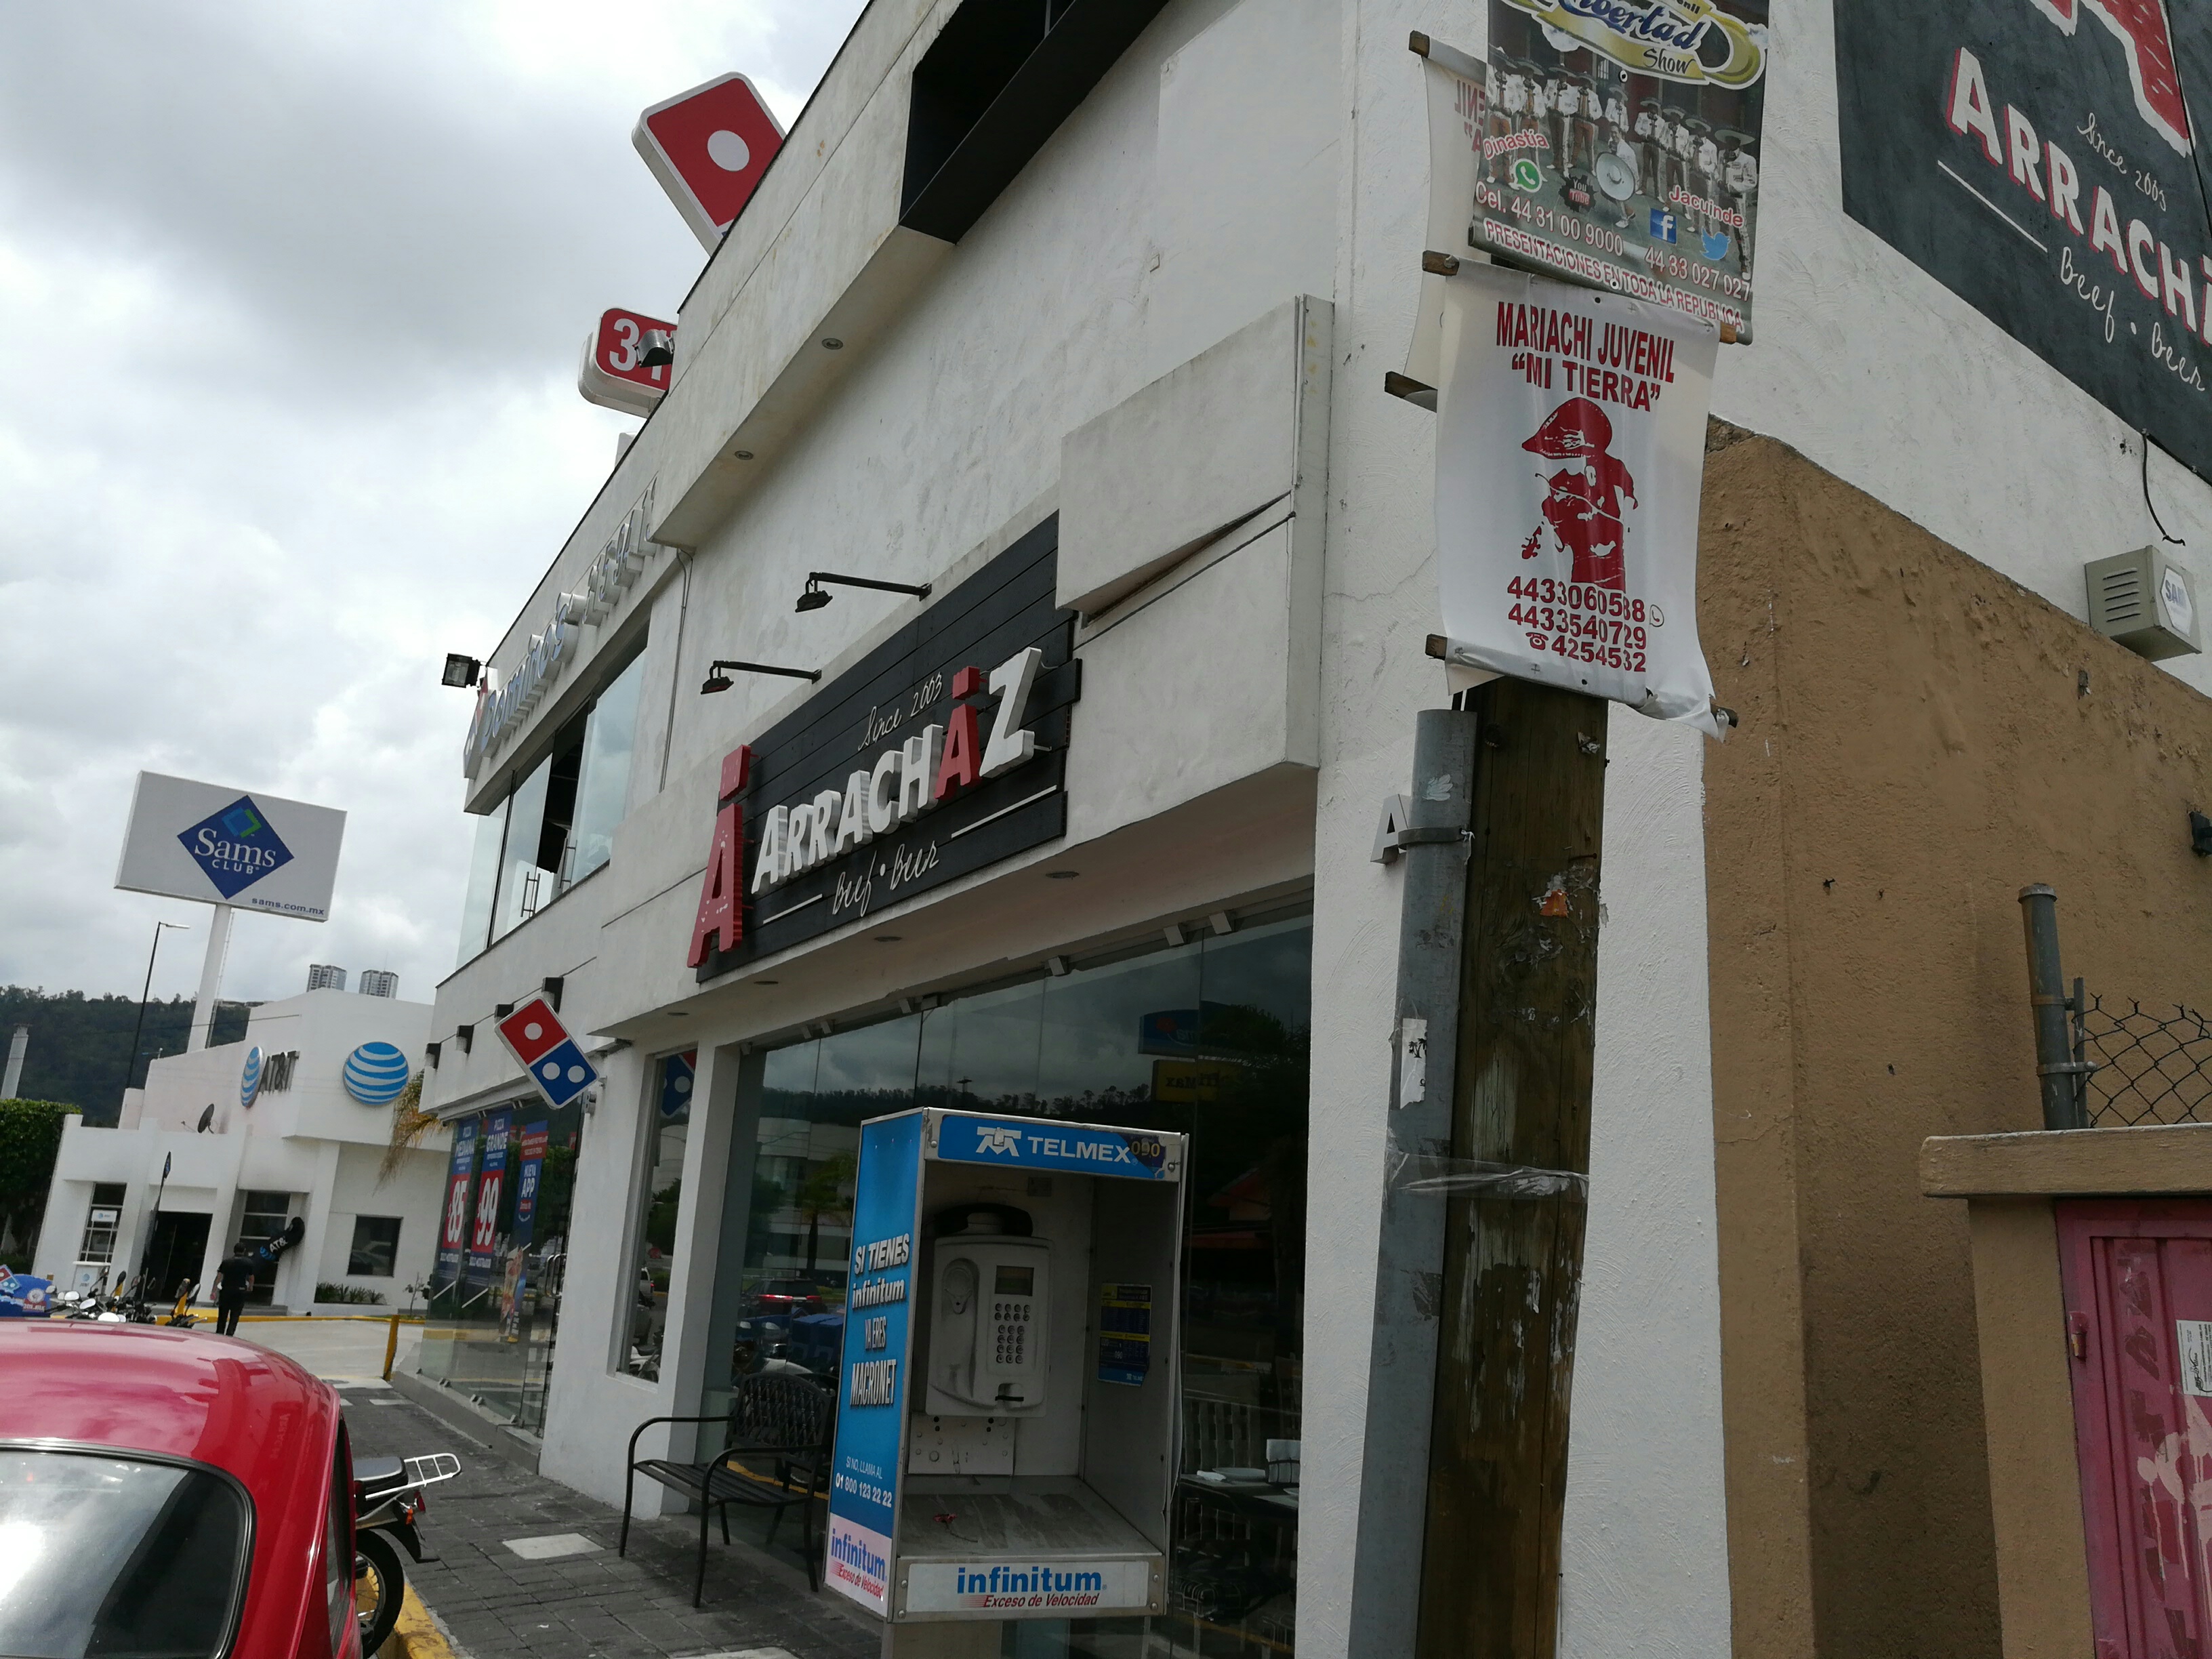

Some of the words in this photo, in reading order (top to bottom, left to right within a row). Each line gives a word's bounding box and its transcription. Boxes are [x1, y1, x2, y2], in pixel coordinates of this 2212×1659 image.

[1643, 48, 1696, 75] Show
[1573, 179, 1586, 192] You
[1946, 46, 2212, 346] ARRACH
[2135, 170, 2167, 211] 2003
[1476, 181, 1506, 213] Cel.
[1511, 197, 1532, 222] 44
[1536, 206, 1554, 232] 31
[1560, 215, 1580, 240] 00
[1585, 224, 1623, 255] 9000
[1669, 185, 1744, 228] Jacuinde
[1484, 218, 1603, 282] PRESENTACIONES
[1622, 270, 1656, 302] TODA
[1656, 282, 1674, 306] LA
[1675, 288, 1744, 333] REPUBLICA
[1645, 247, 1666, 272] 44
[1669, 255, 1687, 279] 33
[1692, 263, 1719, 290] 027
[1723, 274, 1750, 302] 027
[1496, 302, 1593, 361] MARIACHI
[1597, 323, 1675, 383] JUVENIL
[1507, 576, 1645, 622] 4433060588
[1508, 603, 1647, 649] 4433540729
[1551, 635, 1646, 672] 4254532
[910, 671, 943, 718] 2003
[194, 827, 276, 868] Sams
[211, 859, 255, 875] CLUB
[251, 897, 325, 916] sams.com.mx
[258, 1050, 300, 1094] AT&T
[486, 1132, 508, 1153] GRANDE
[1027, 1136, 1131, 1164] TELMEX
[520, 1177, 536, 1198] APP
[270, 1236, 288, 1252] AT&
[854, 1245, 866, 1275] SI
[868, 1233, 910, 1271] TIENES
[852, 1277, 905, 1309] infinitum
[865, 1319, 873, 1349] YA
[872, 1315, 886, 1349] ERES
[850, 1359, 897, 1406] MACRONET
[846, 1456, 851, 1469] SI
[859, 1462, 876, 1477] LLAMA
[876, 1466, 883, 1479] AL
[835, 1473, 844, 1490] 01
[844, 1476, 857, 1494] 800
[859, 1481, 871, 1500] 123
[872, 1486, 881, 1504] 22
[882, 1492, 893, 1508] 22
[831, 1528, 886, 1582] infinitum
[838, 1564, 855, 1584] Exceso
[855, 1575, 861, 1588] de
[861, 1575, 884, 1599] Velocidad
[957, 1565, 1102, 1594] infinitum
[983, 1595, 1025, 1608] Exceso
[1027, 1594, 1042, 1607] de
[1046, 1593, 1100, 1607] Velocidad
